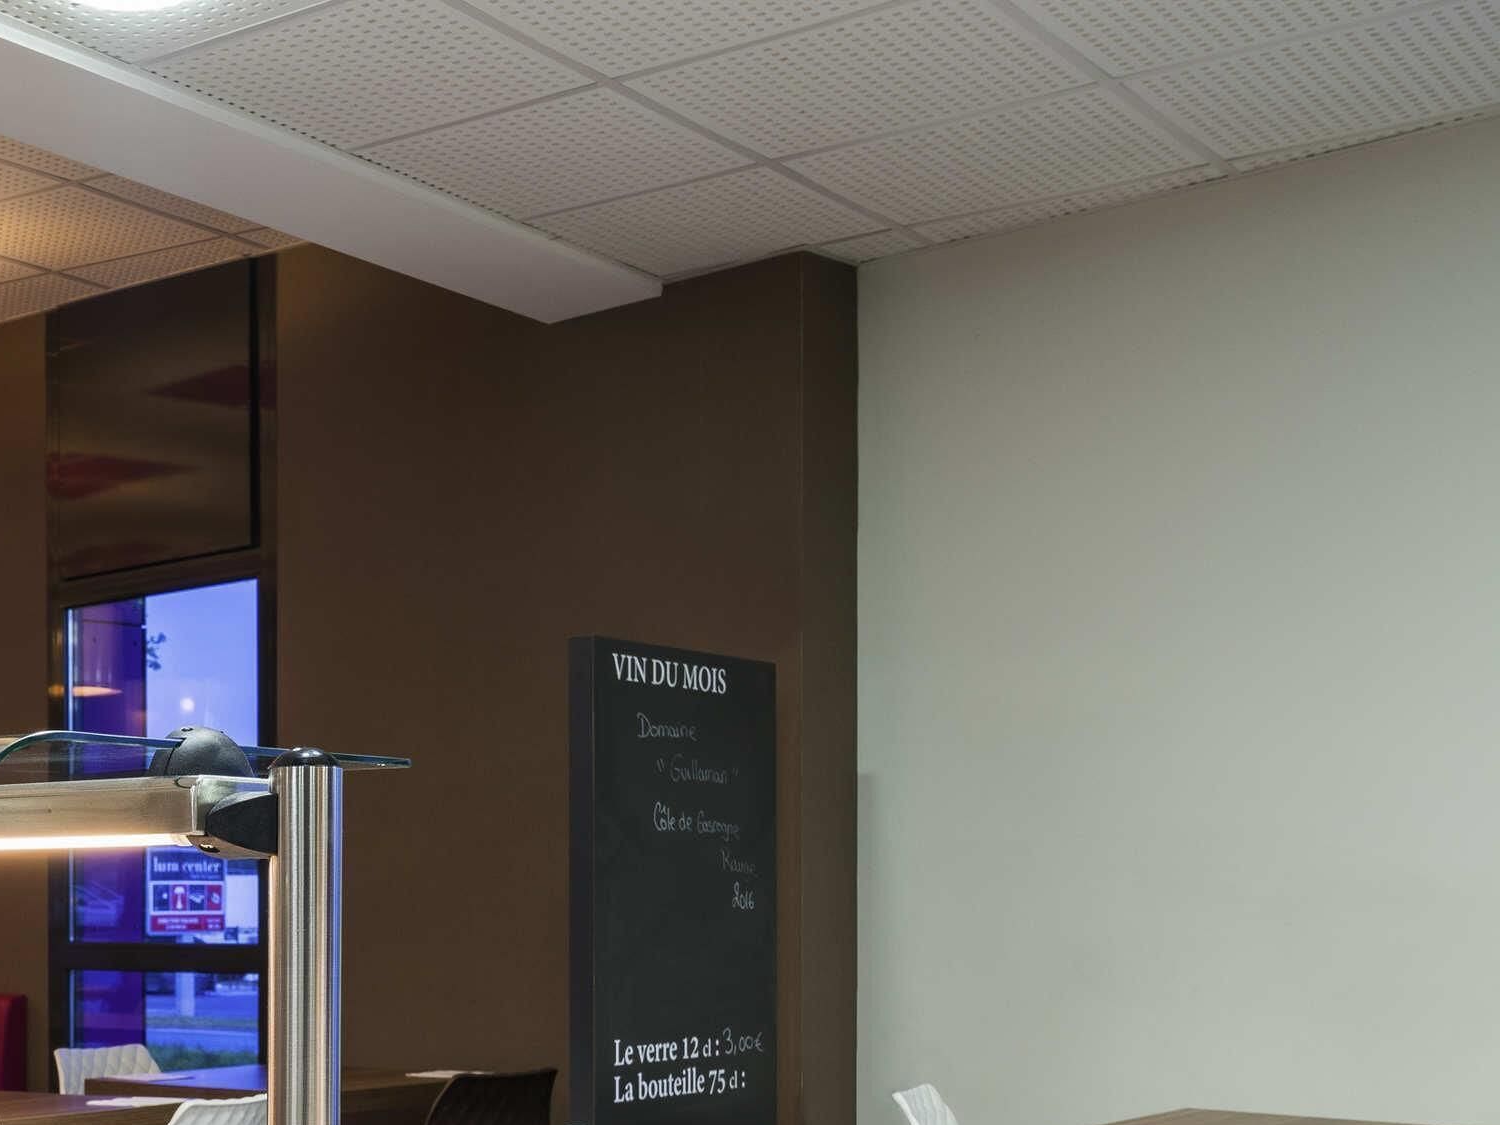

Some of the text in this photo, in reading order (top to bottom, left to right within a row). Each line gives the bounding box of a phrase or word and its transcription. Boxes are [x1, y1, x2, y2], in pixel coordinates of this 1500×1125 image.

[612, 653, 727, 695] VIN DU MOIS
[636, 712, 699, 741] Domaine
[678, 813, 693, 830] de
[614, 1039, 633, 1066] Le
[637, 1042, 678, 1064] verre
[683, 1036, 699, 1060] 12
[614, 1076, 634, 1103] La
[638, 1067, 705, 1100] bouteille
[709, 1069, 726, 1095] 75
